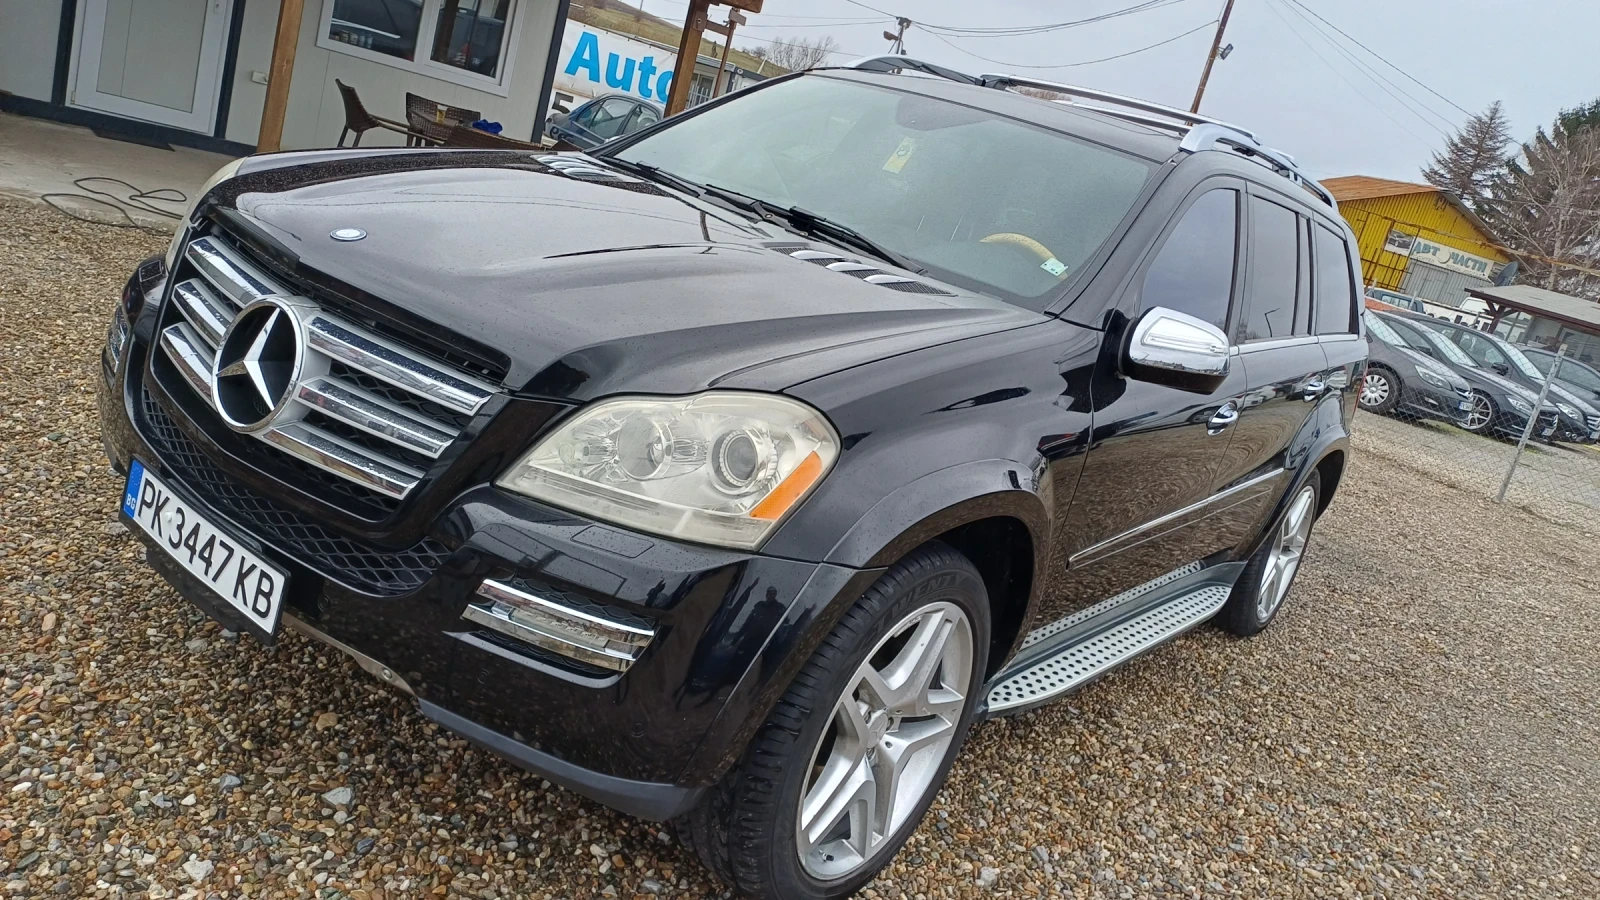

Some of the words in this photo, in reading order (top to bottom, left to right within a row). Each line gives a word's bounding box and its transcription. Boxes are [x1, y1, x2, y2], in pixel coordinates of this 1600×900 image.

[125, 493, 136, 510] BG
[137, 477, 169, 539] PK
[168, 507, 235, 583] 3447
[232, 555, 275, 619] KB
